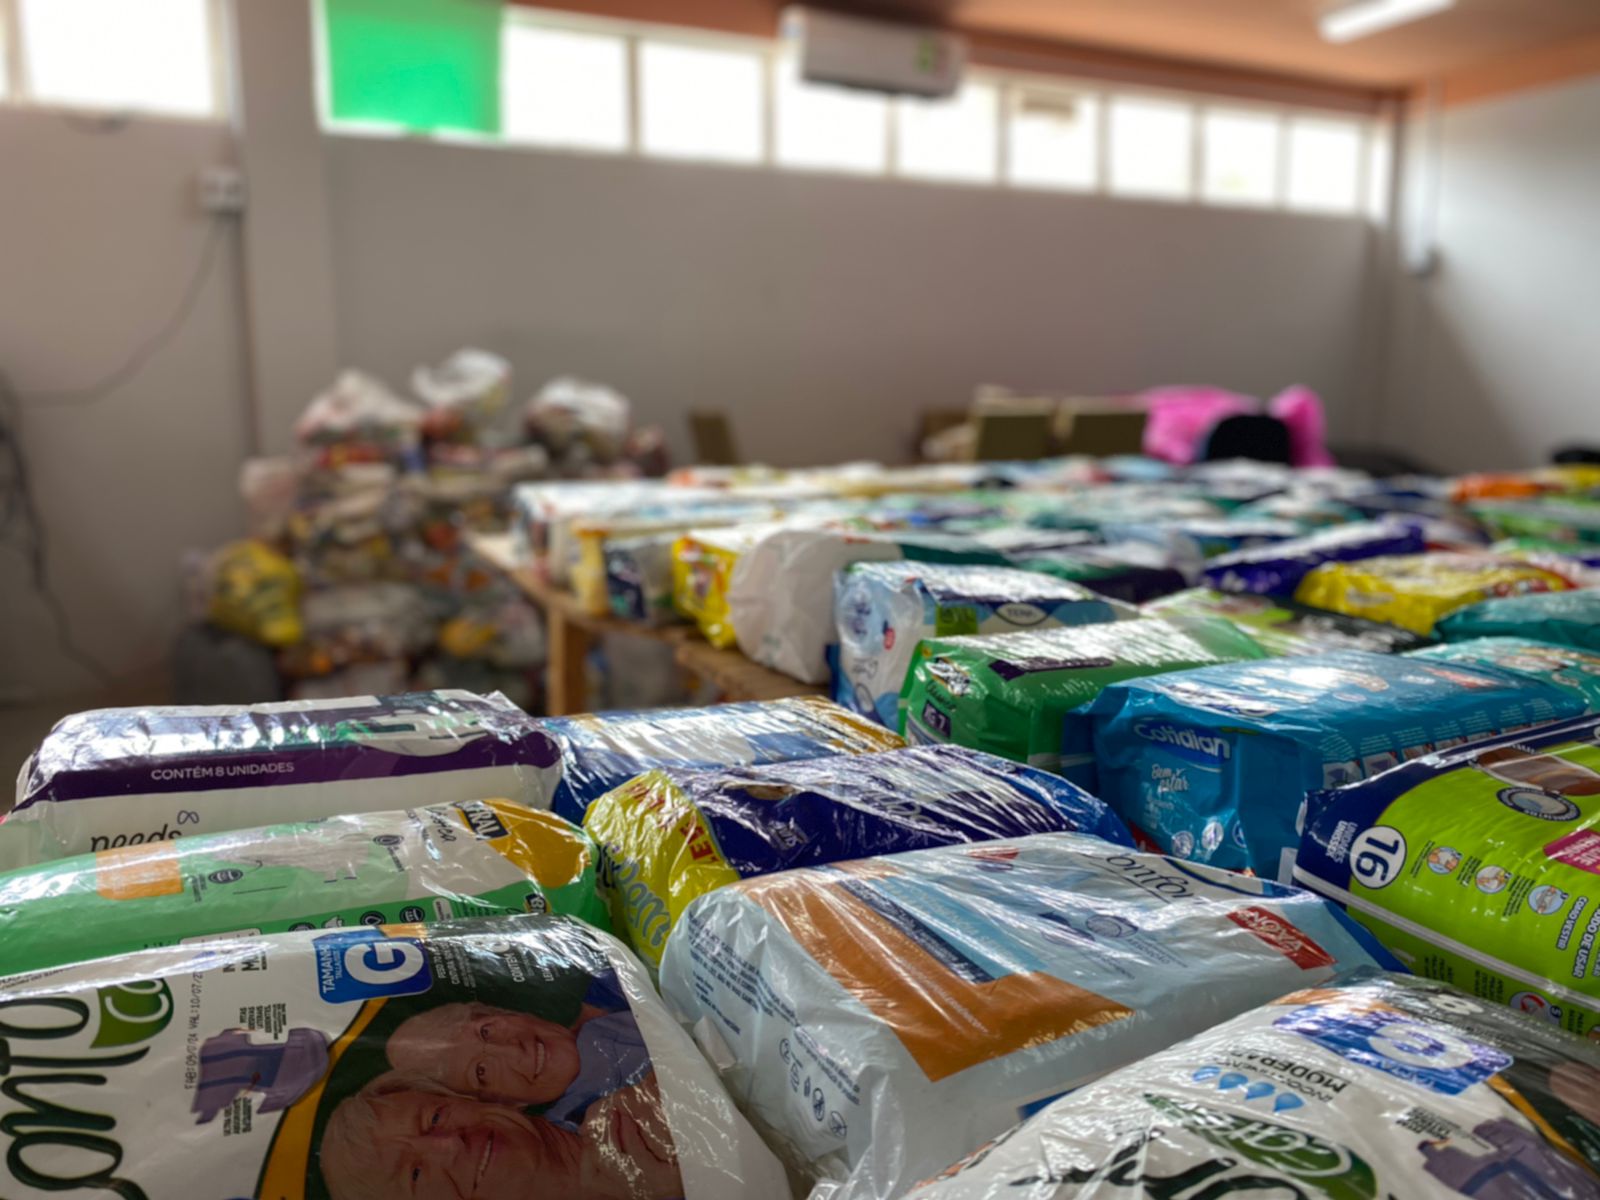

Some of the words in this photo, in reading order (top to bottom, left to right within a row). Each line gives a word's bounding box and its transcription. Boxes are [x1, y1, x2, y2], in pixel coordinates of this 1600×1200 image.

[1133, 724, 1231, 759] Cotidian
[151, 765, 213, 781] CONTÉM
[215, 767, 225, 778] 8
[226, 762, 295, 777] UNIDADES
[1355, 836, 1400, 882] 16
[344, 940, 424, 985] G
[1573, 951, 1588, 978] USAR
[1228, 1045, 1350, 1093] MODERA
